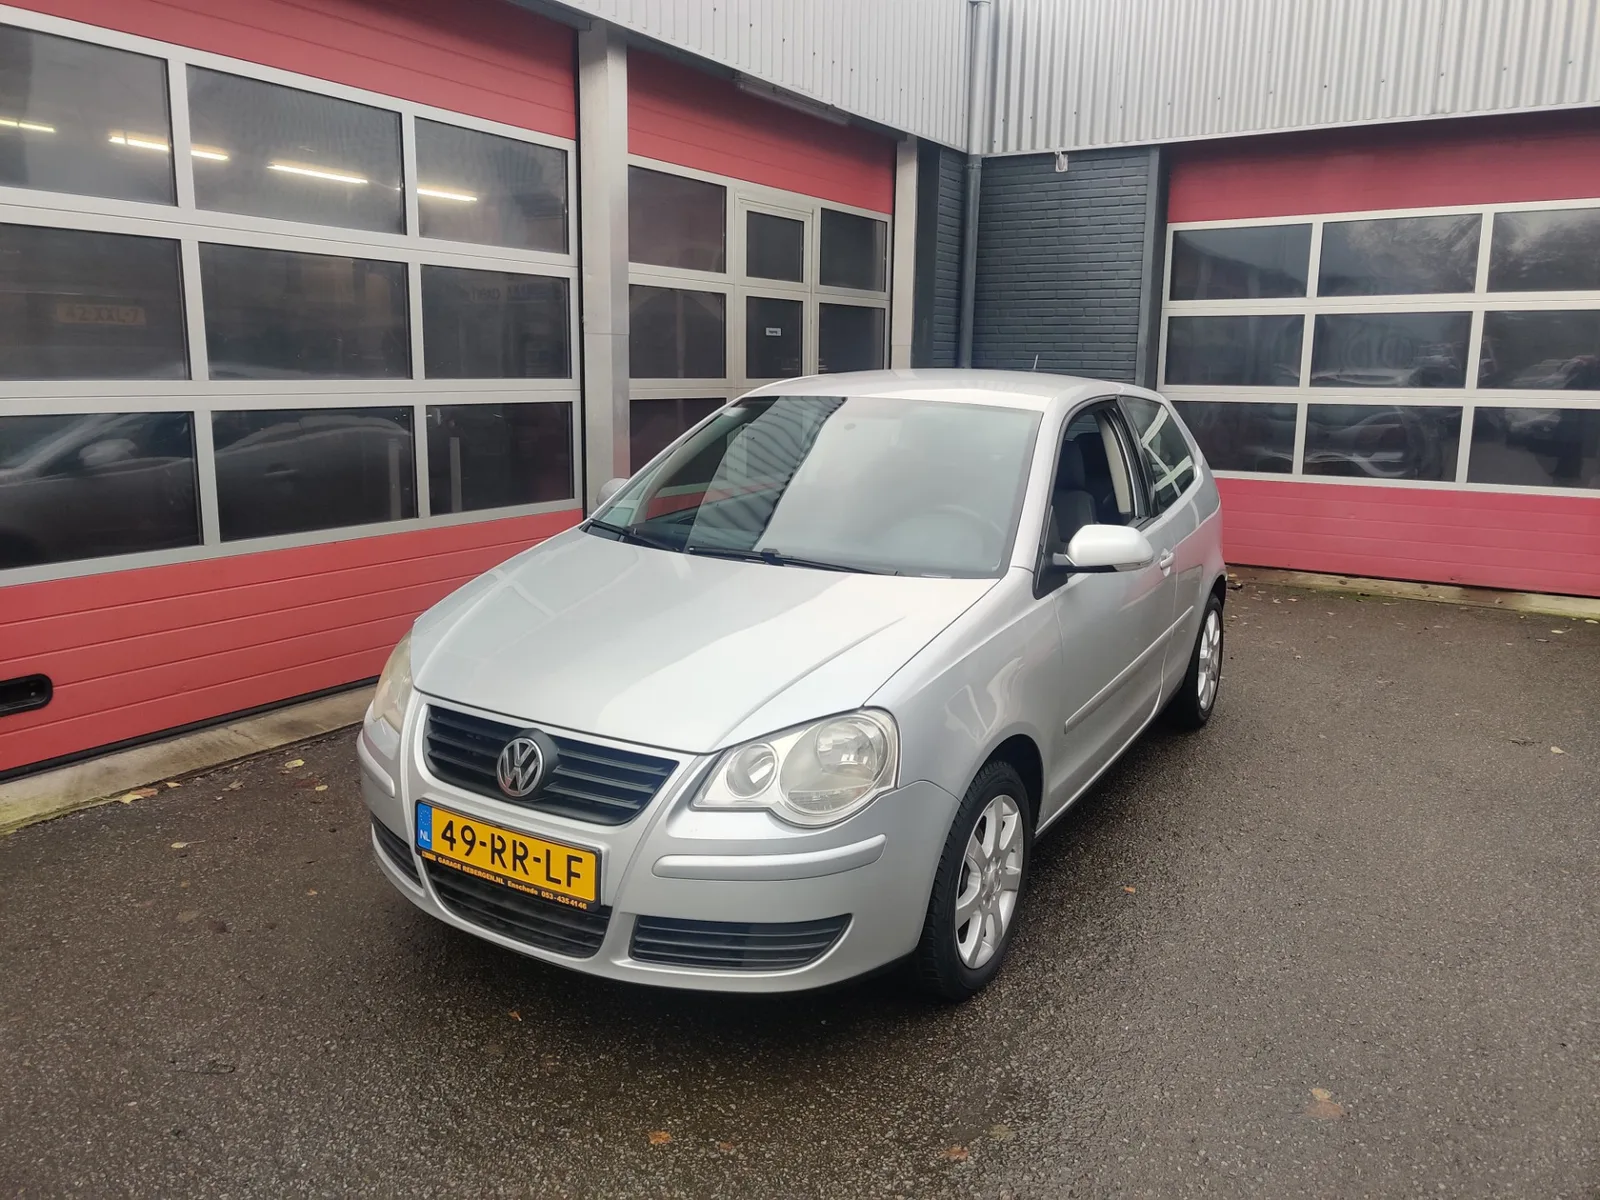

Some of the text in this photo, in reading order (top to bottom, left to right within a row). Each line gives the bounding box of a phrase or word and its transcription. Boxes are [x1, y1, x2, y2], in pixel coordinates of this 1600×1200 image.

[419, 830, 431, 842] NL
[441, 820, 583, 887] 49-RR-LF
[438, 857, 462, 870] GARAGE
[507, 880, 538, 895] Enschede
